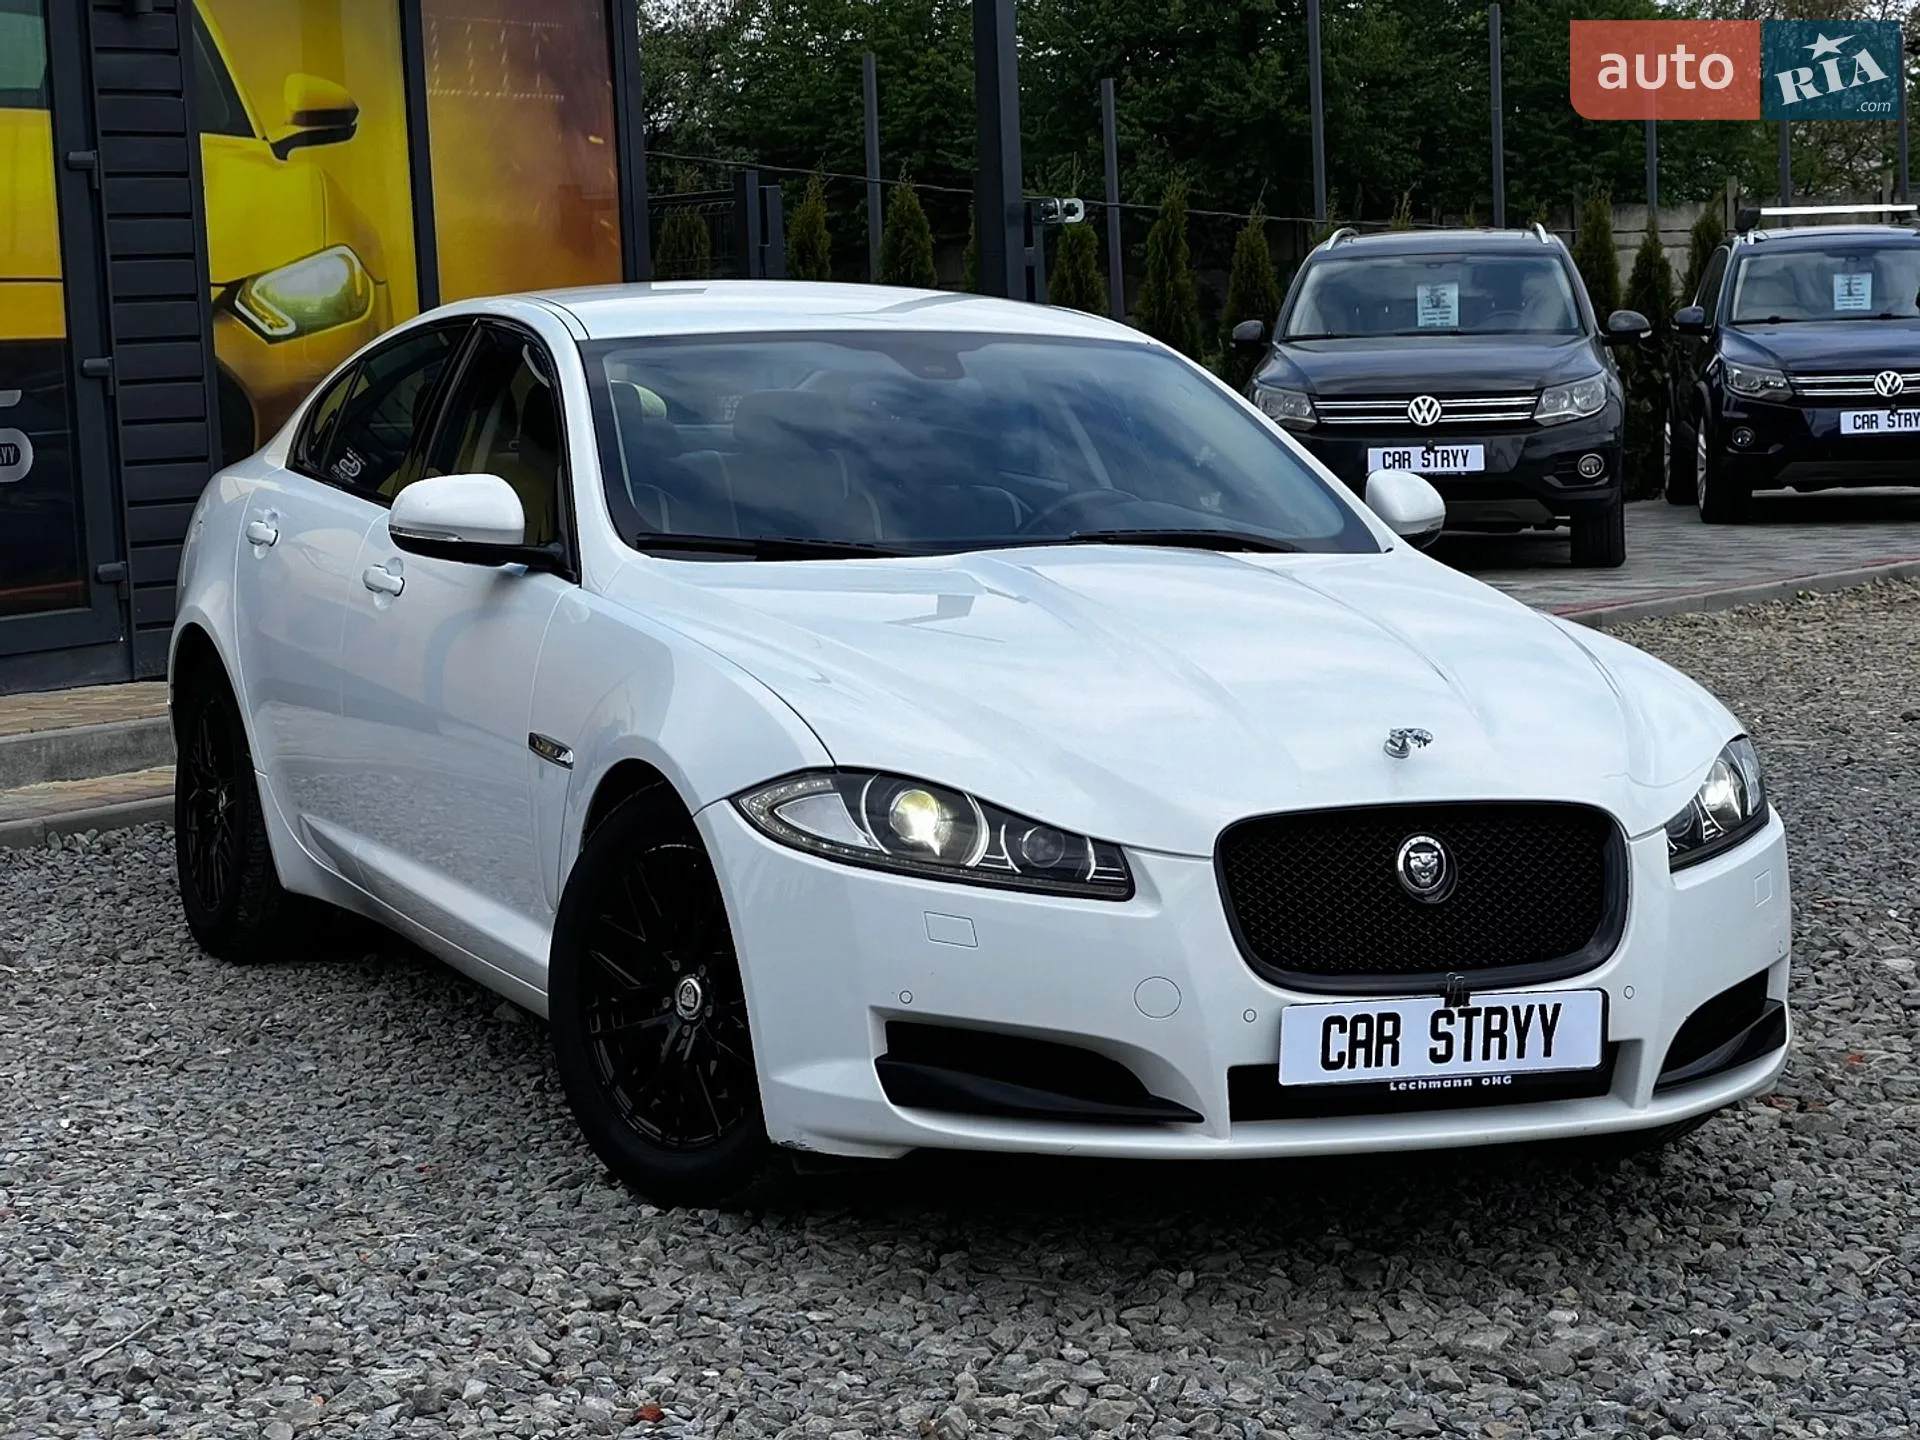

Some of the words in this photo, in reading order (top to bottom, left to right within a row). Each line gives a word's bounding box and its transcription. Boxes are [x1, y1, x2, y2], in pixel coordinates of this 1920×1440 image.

[1853, 413, 1879, 430] CAR
[1382, 451, 1411, 470] CAR
[1421, 449, 1469, 468] STRYY
[1320, 1011, 1401, 1071] CAR
[1428, 1003, 1562, 1064] STRYY
[1389, 1077, 1473, 1091] Lechmann
